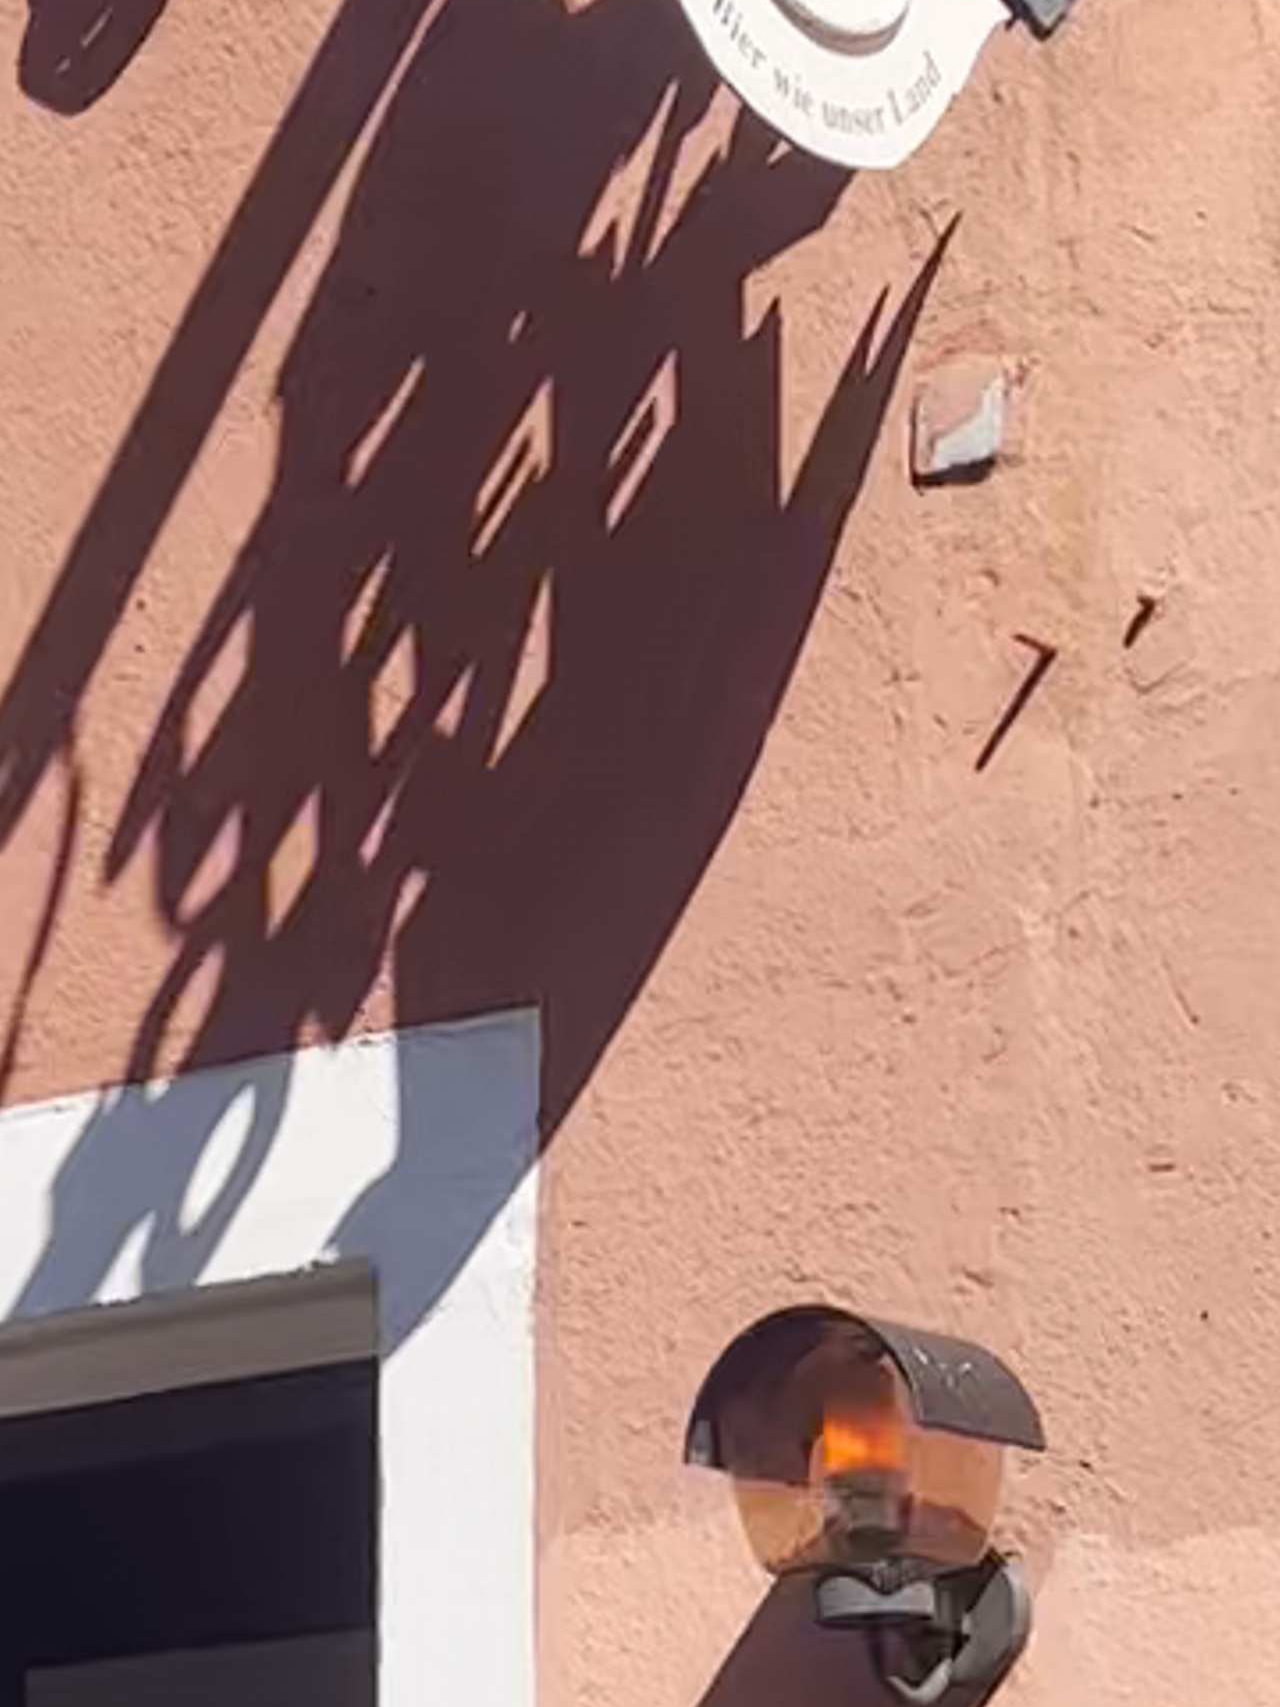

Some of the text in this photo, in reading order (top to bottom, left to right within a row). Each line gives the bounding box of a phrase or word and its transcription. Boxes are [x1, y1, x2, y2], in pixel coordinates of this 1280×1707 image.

[773, 66, 815, 118] wie
[821, 100, 887, 136] unser
[886, 47, 943, 127] Land
